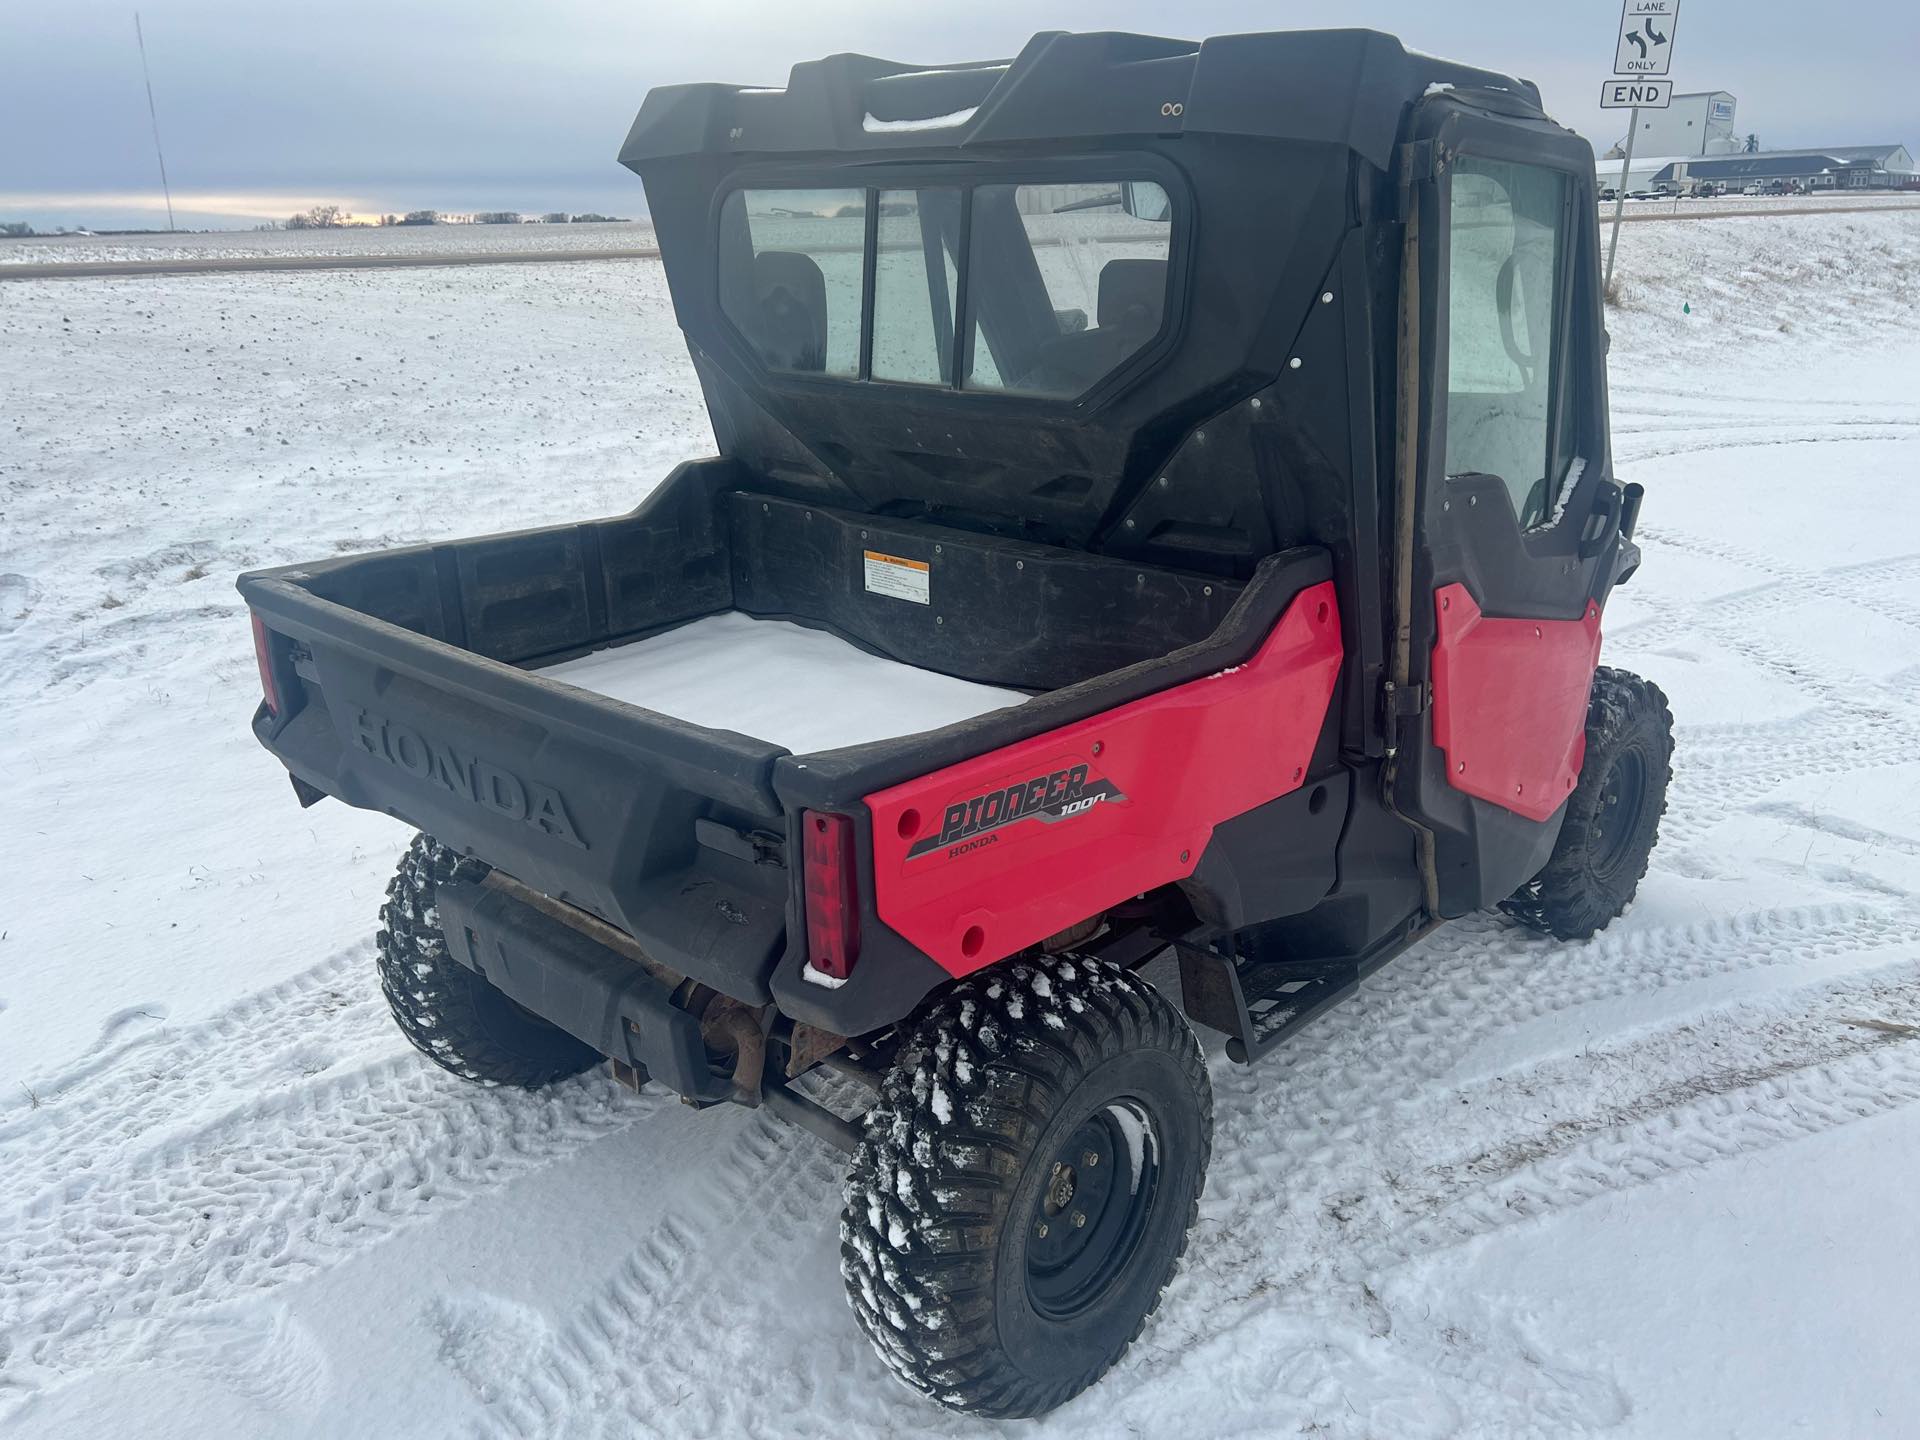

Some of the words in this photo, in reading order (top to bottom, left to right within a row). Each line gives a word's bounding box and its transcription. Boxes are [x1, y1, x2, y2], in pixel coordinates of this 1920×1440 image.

[1637, 2, 1666, 11] LANE
[1627, 61, 1657, 70] ONLY
[1614, 86, 1659, 102] END
[351, 708, 590, 850] HONDA
[939, 763, 1089, 844] PIONEER
[948, 834, 999, 860] HONDA
